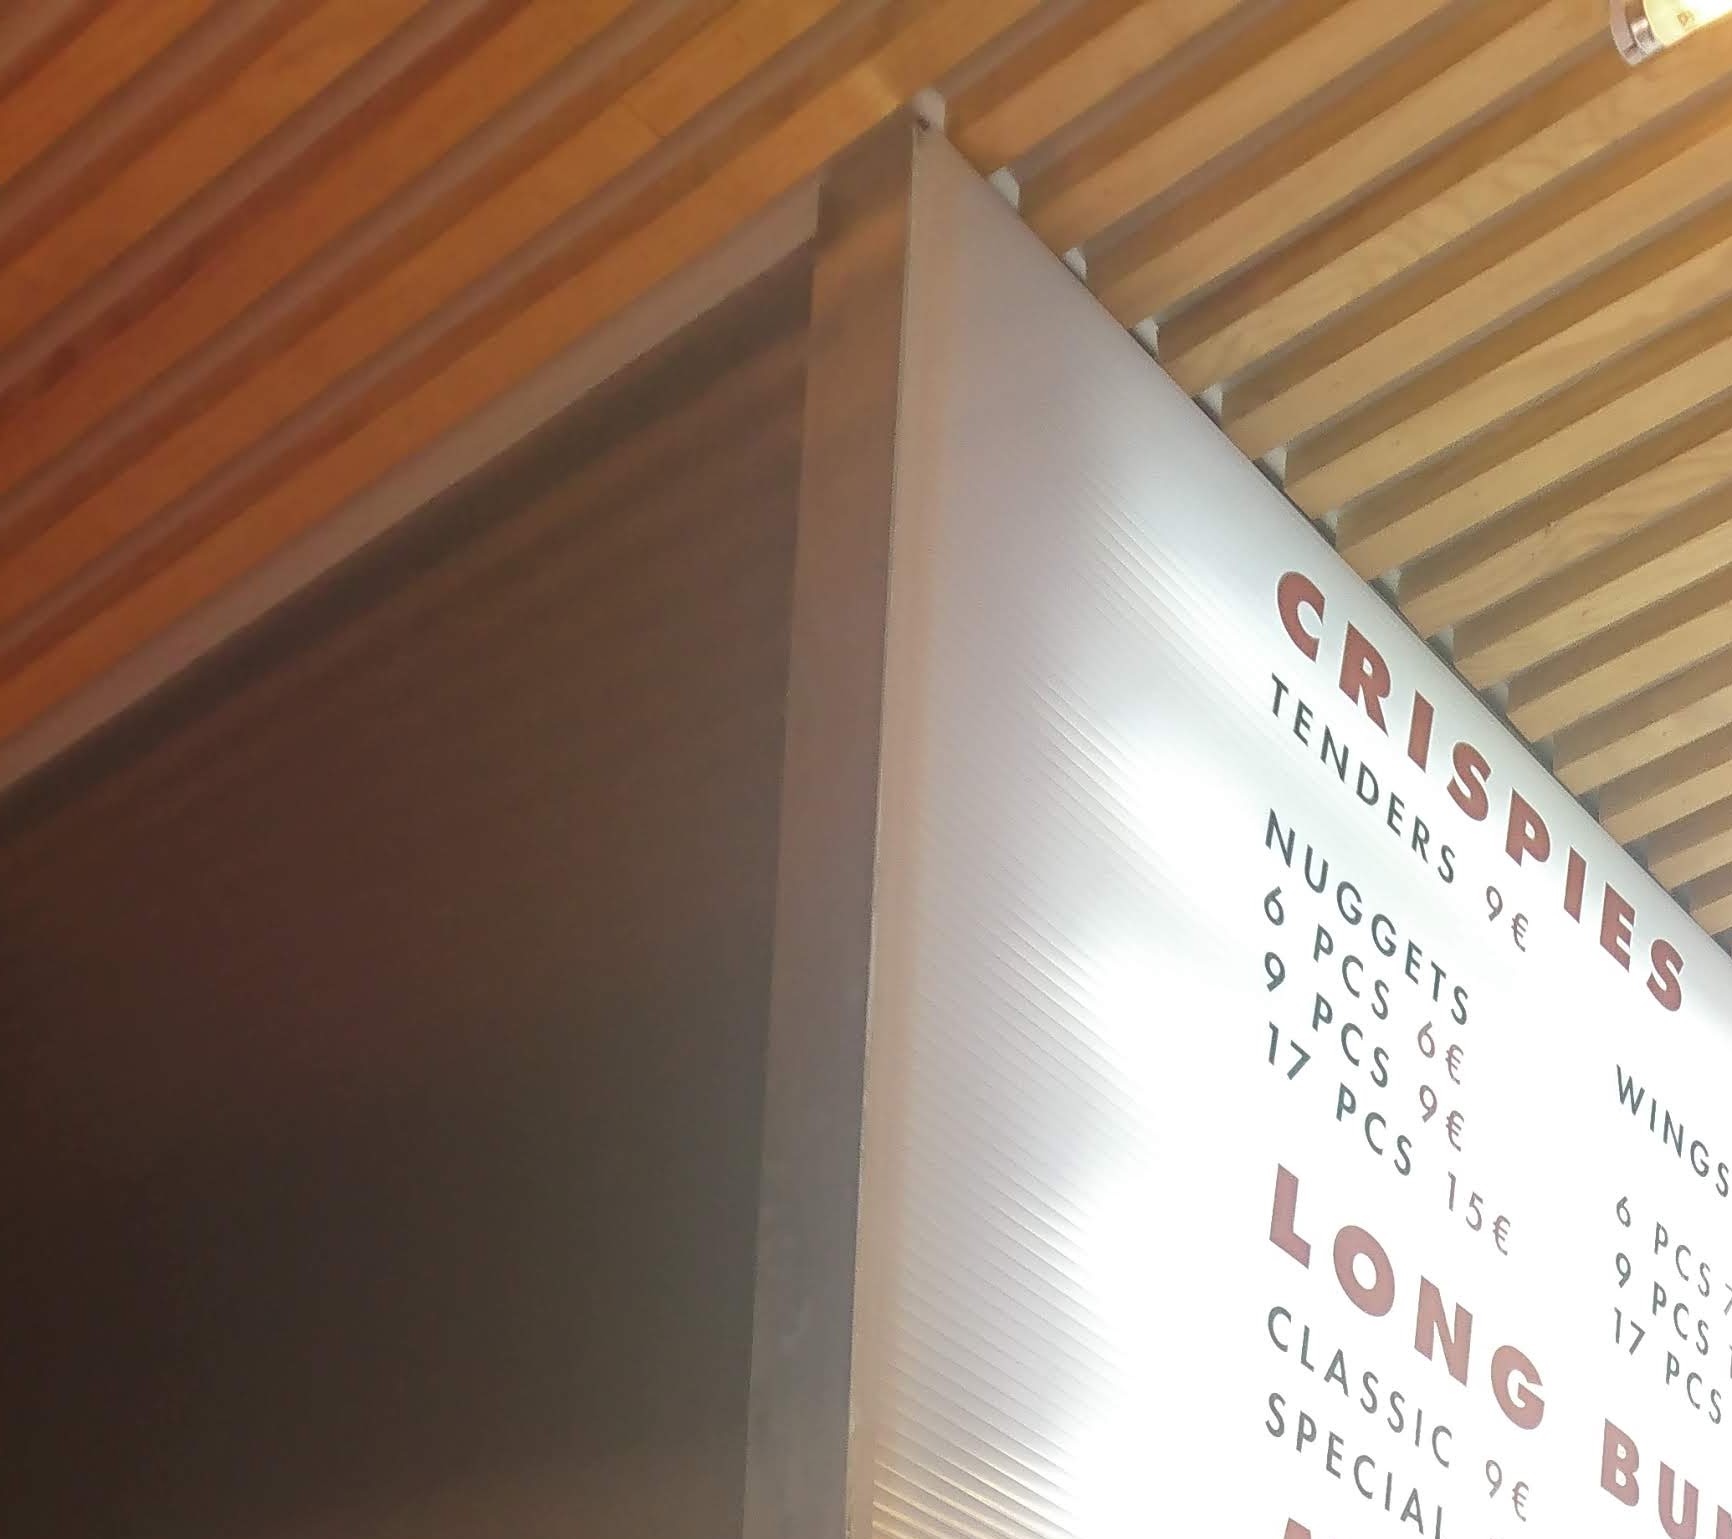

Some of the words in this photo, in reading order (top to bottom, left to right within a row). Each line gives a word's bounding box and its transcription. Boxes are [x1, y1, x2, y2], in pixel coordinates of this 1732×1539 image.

[1270, 674, 1456, 884] TENDERS
[1485, 885, 1528, 952] 9€
[1277, 571, 1685, 1013] CRISPIES
[1265, 886, 1283, 926] 6
[1312, 924, 1389, 1020] PCS
[1417, 1021, 1463, 1085] 6€
[1266, 809, 1469, 1026] NUGGETS
[1264, 1021, 1311, 1081] 17
[1335, 1083, 1411, 1176] PCS
[1446, 1171, 1511, 1256] 15€
[1265, 951, 1286, 993] 9
[1311, 992, 1389, 1088] PCS
[1418, 1086, 1465, 1151] 9€
[1617, 1065, 1730, 1198] WINGS
[1269, 1163, 1545, 1430] LONG
[1615, 1253, 1631, 1288] 9
[1652, 1281, 1709, 1356] PCS
[1616, 1197, 1631, 1228] 6
[1652, 1222, 1711, 1298] PCS
[1268, 1306, 1452, 1468] CLASSIC
[1485, 1460, 1529, 1522] 9€
[1614, 1307, 1645, 1355] 17
[1665, 1352, 1721, 1424] PCS
